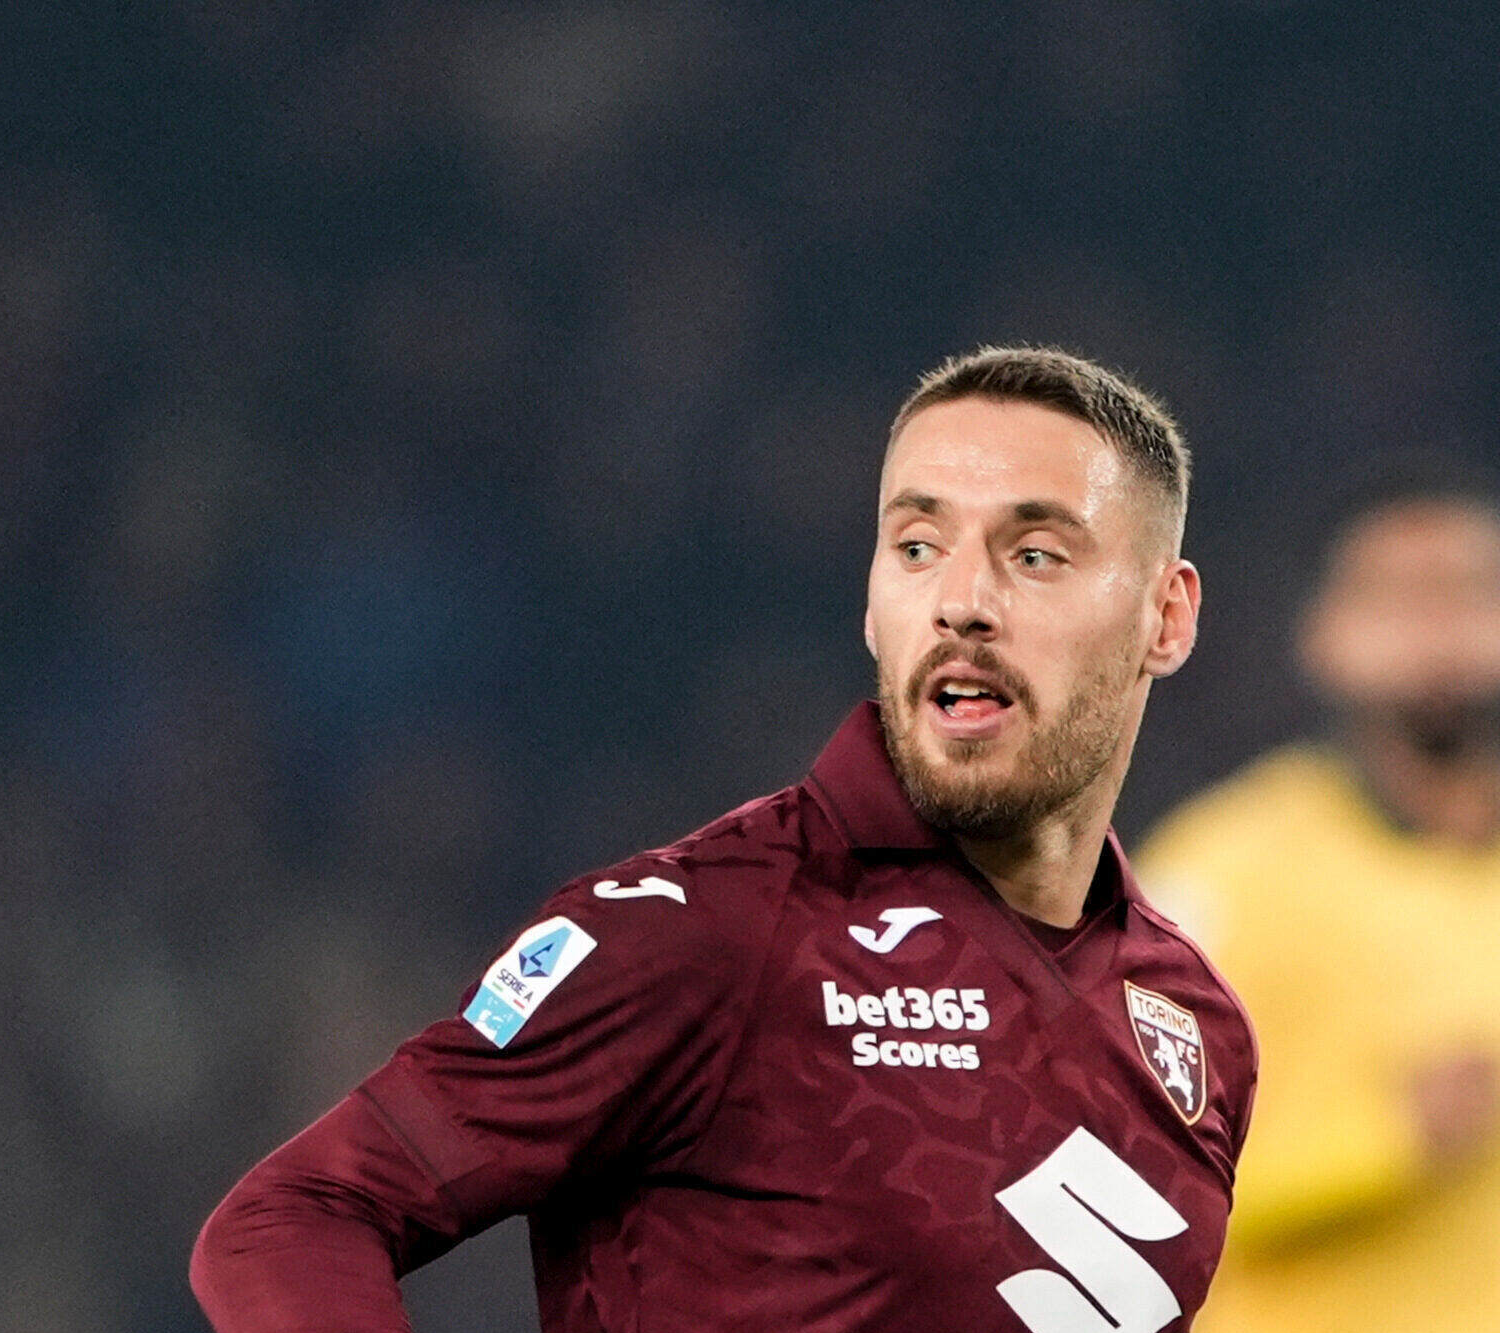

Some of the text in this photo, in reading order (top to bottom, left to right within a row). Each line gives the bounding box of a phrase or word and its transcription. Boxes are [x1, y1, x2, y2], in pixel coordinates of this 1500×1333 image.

[496, 968, 535, 1003] SERIE A
[821, 981, 990, 1031] bet365
[1134, 996, 1193, 1036] TORINO
[851, 1032, 980, 1070] Scores
[1175, 1039, 1199, 1066] FC
